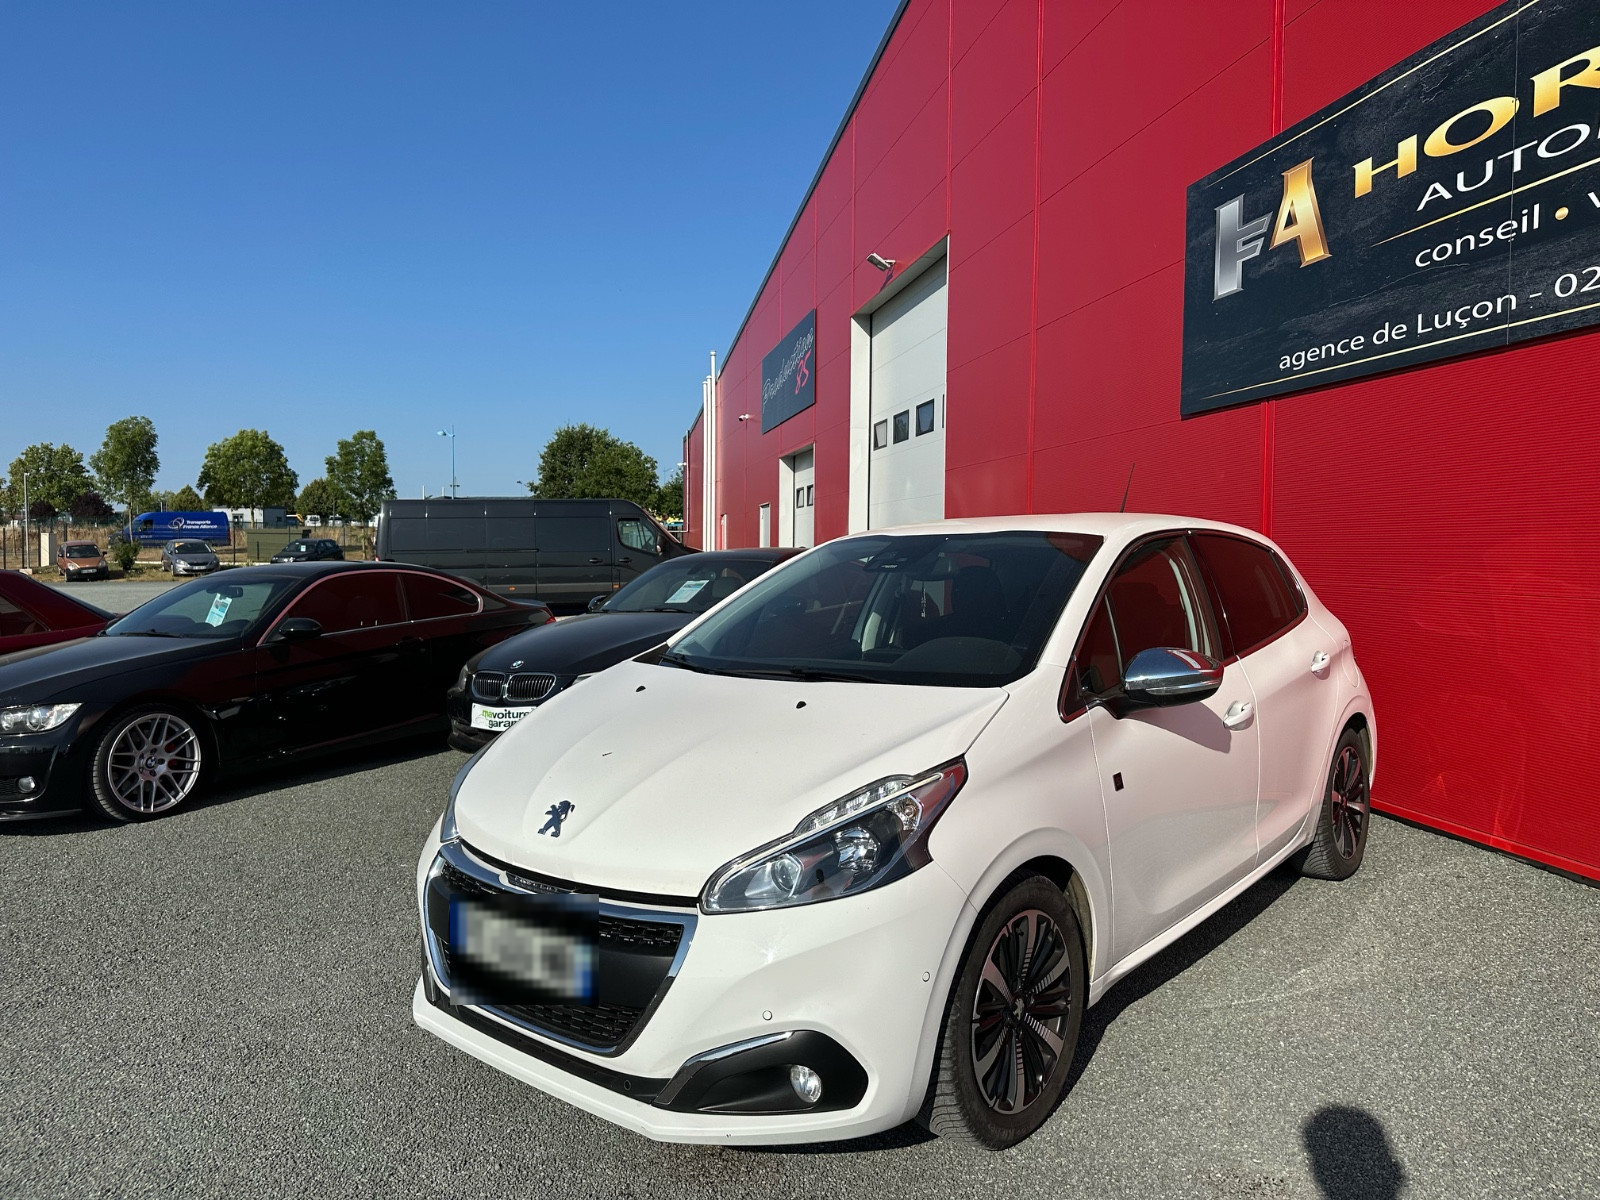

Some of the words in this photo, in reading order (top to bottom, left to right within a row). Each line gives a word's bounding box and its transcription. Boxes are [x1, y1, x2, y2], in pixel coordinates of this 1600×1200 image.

[1352, 45, 1600, 199] HOR
[1416, 123, 1600, 212] AUTO
[1414, 202, 1541, 268] conseil
[1278, 335, 1365, 371] agence
[1372, 321, 1408, 345] de
[1416, 293, 1517, 334] Luçon
[1554, 265, 1600, 298] 02
